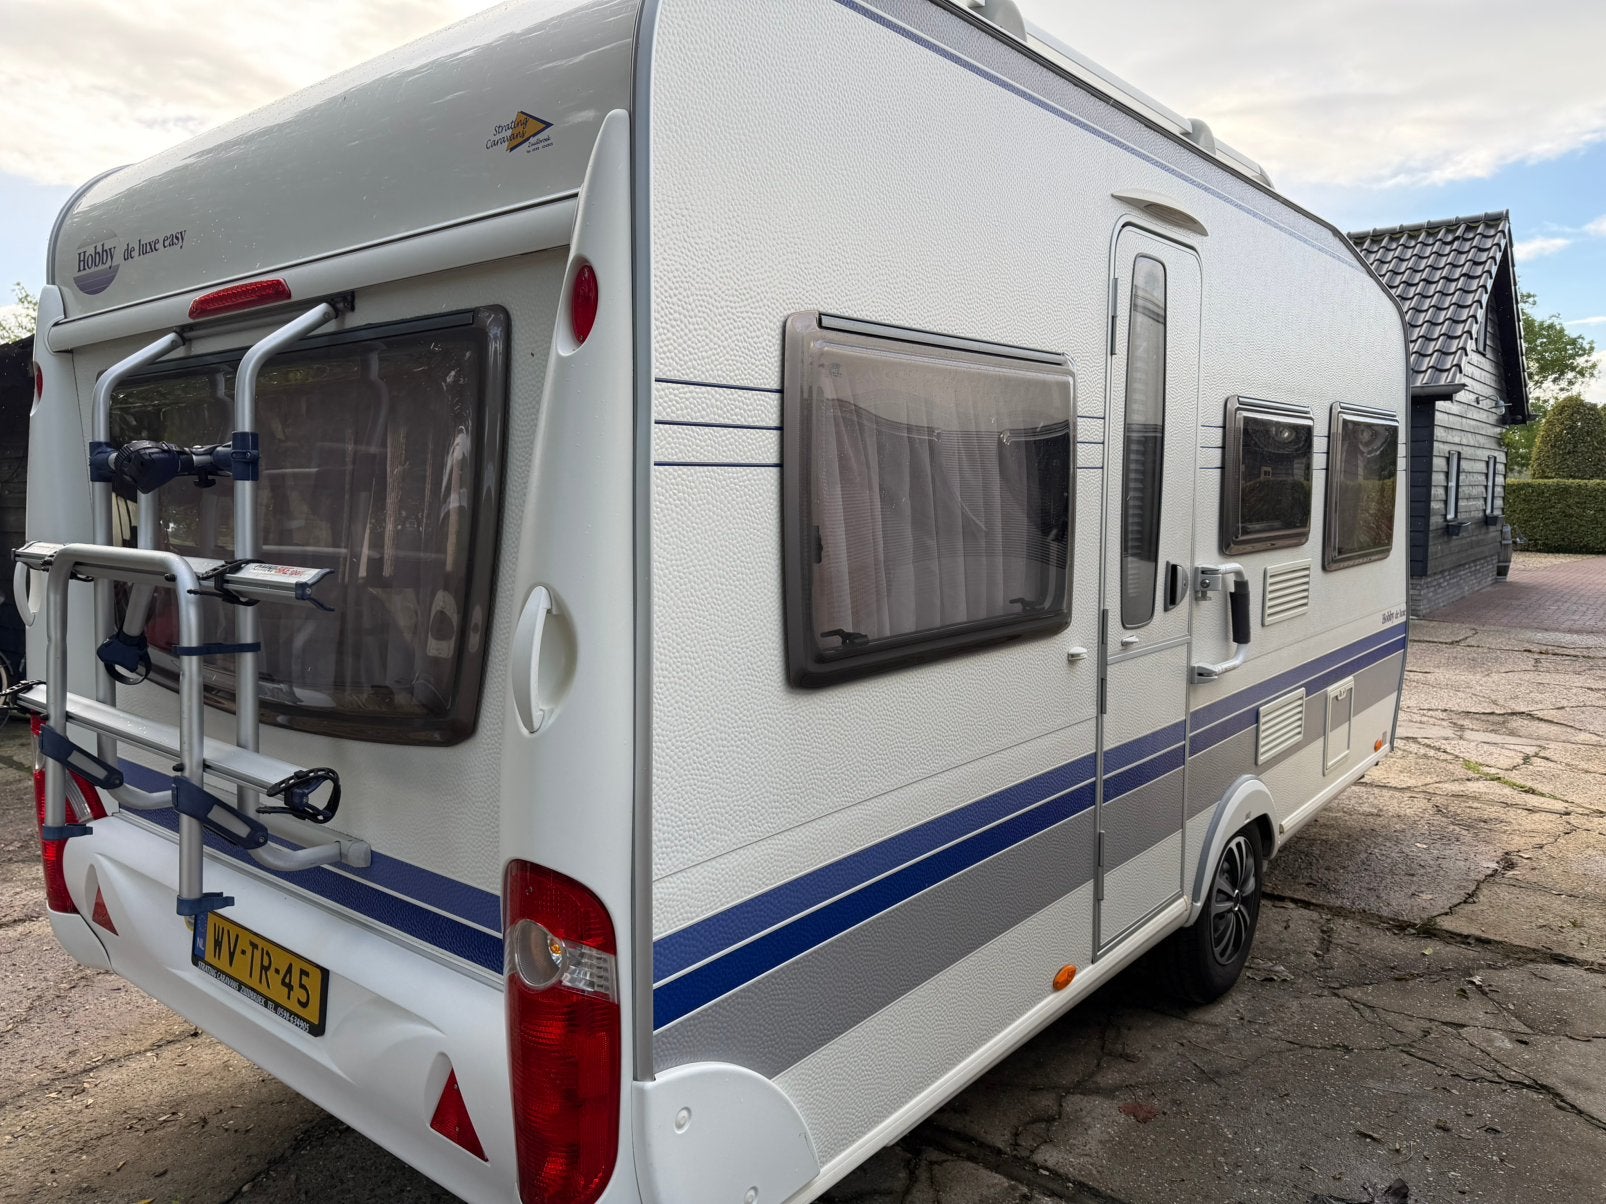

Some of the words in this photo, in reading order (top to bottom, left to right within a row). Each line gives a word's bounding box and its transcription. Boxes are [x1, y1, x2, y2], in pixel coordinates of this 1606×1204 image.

[494, 117, 528, 136] Strating
[486, 130, 526, 149] Caravans
[77, 243, 116, 272] Hobby
[123, 242, 135, 261] de
[138, 239, 160, 257] luxe
[162, 230, 187, 249] easy
[196, 937, 204, 951] NL
[213, 922, 310, 1009] WV-TR-45
